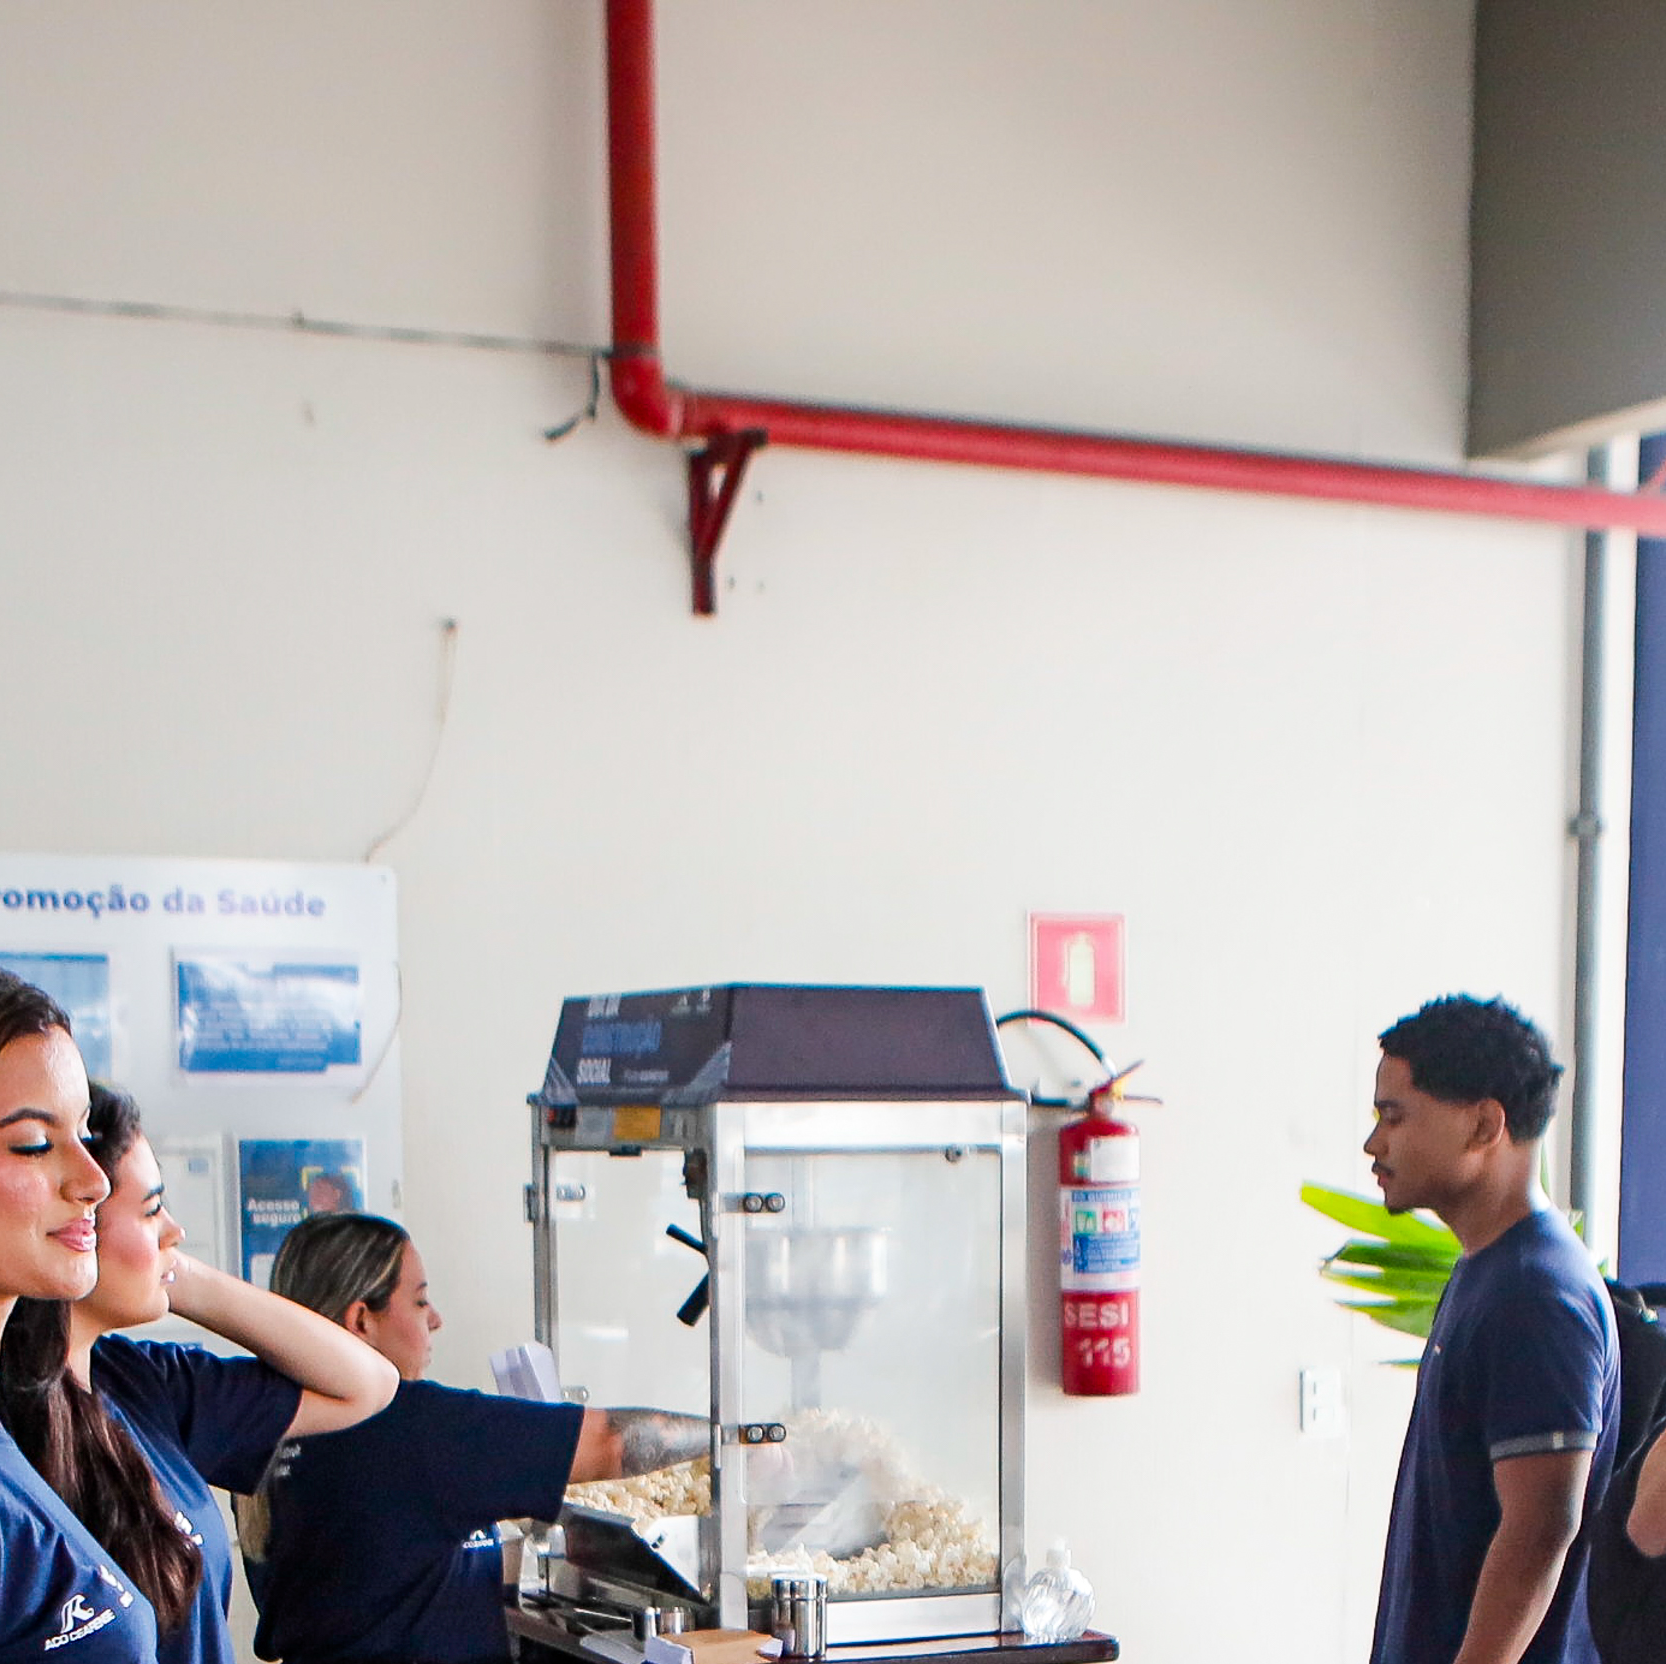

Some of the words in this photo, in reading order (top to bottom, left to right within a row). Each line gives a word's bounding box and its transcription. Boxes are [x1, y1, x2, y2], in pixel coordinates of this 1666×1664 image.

[164, 886, 204, 914] da
[218, 885, 326, 917] Saúde
[247, 1198, 301, 1212] Acesso
[1064, 1302, 1130, 1328] SESI
[1079, 1337, 1131, 1368] 115
